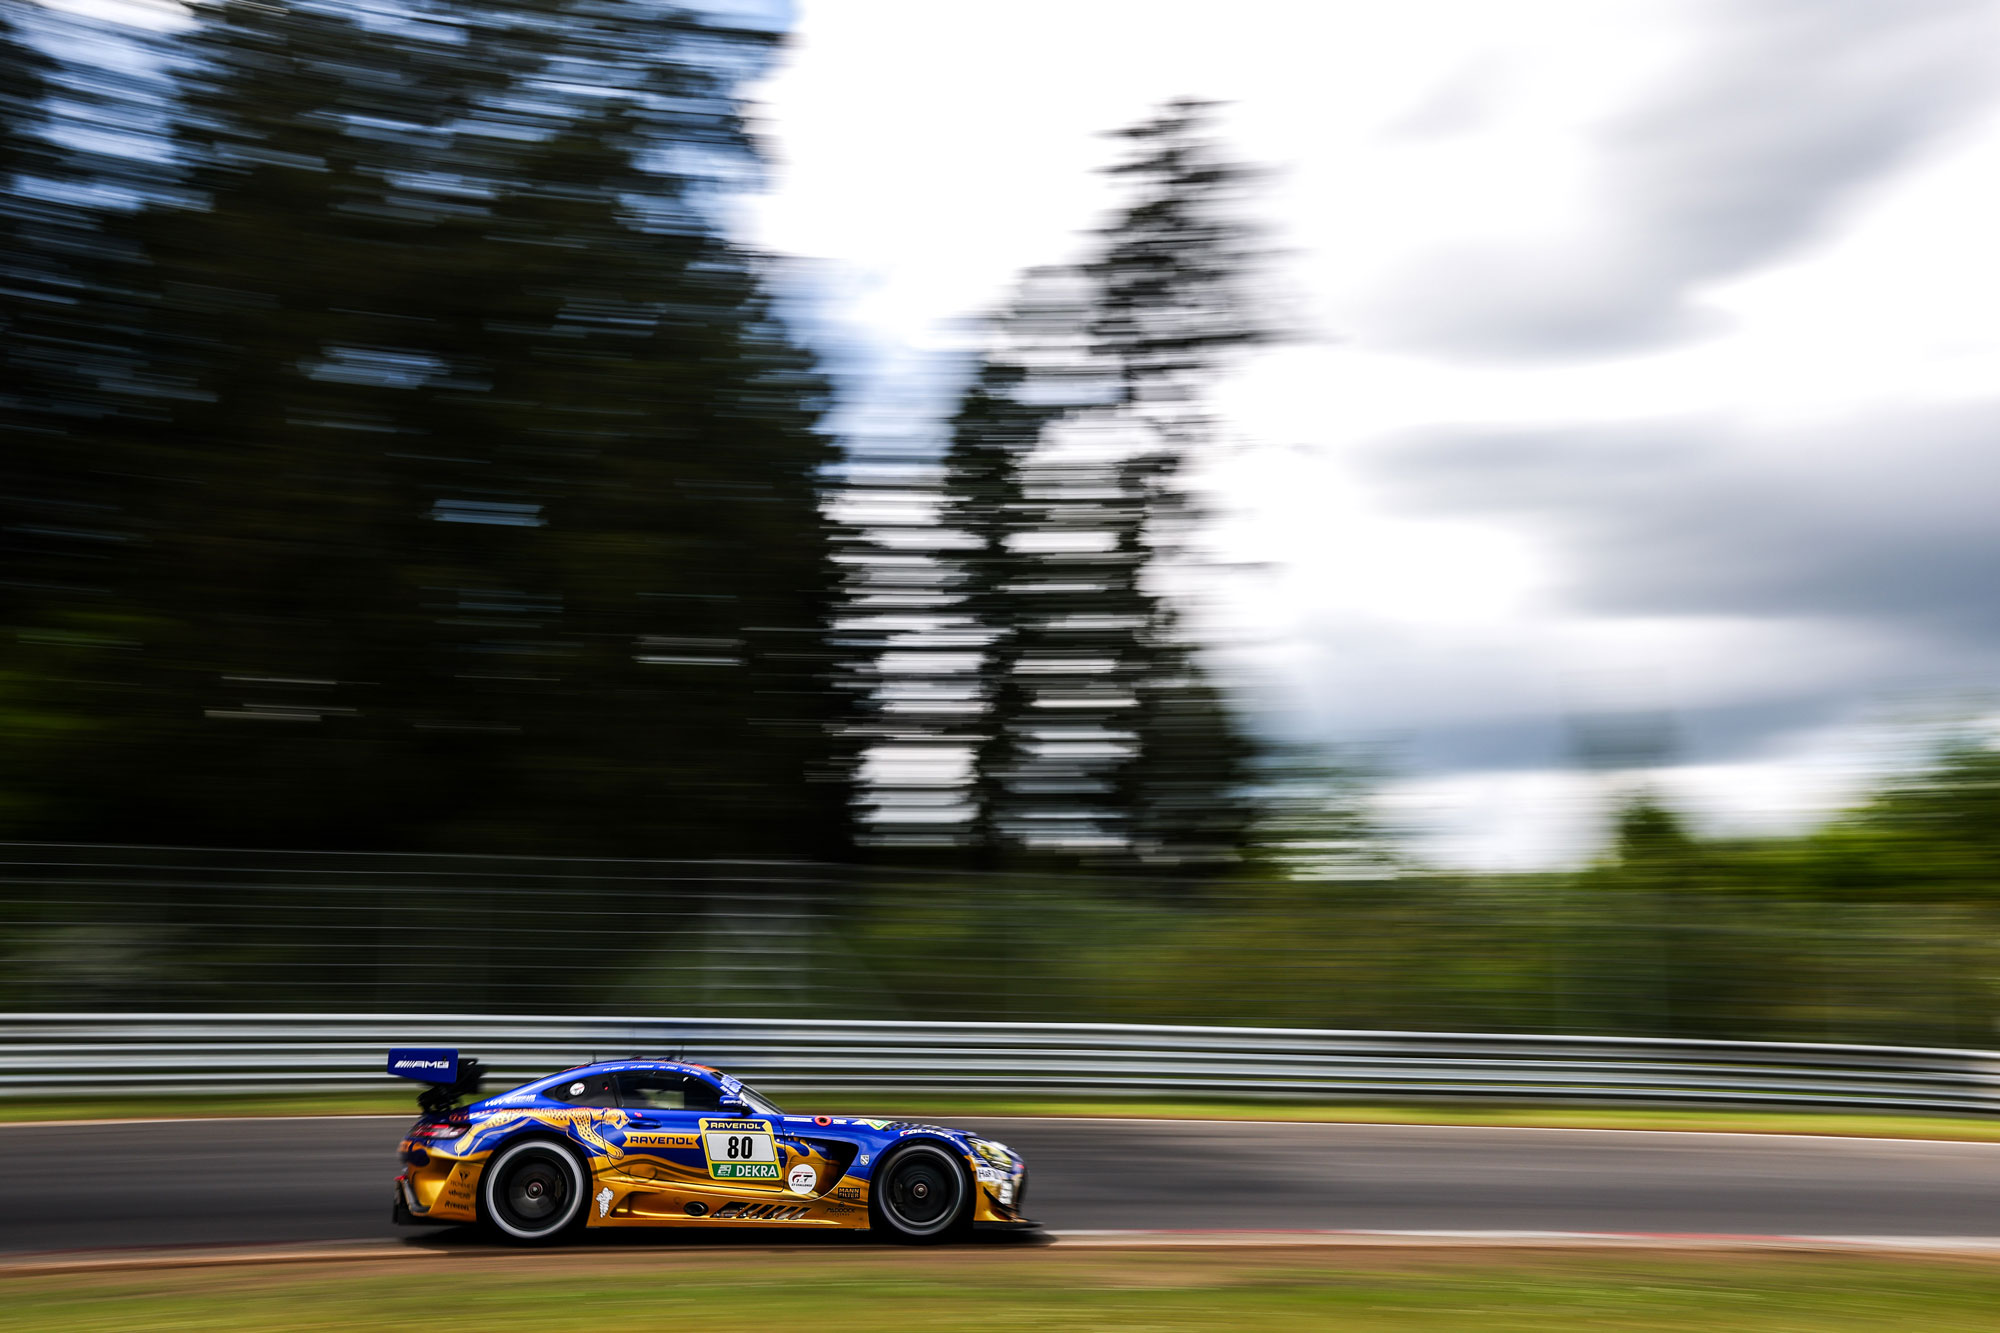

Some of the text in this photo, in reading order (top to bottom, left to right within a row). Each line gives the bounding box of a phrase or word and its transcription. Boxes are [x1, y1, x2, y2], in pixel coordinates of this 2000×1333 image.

[413, 1060, 449, 1069] AMG
[710, 1121, 761, 1130] RAVENOL
[630, 1136, 693, 1146] RAVENOL
[727, 1136, 753, 1160] 80
[736, 1165, 778, 1177] DEKRA
